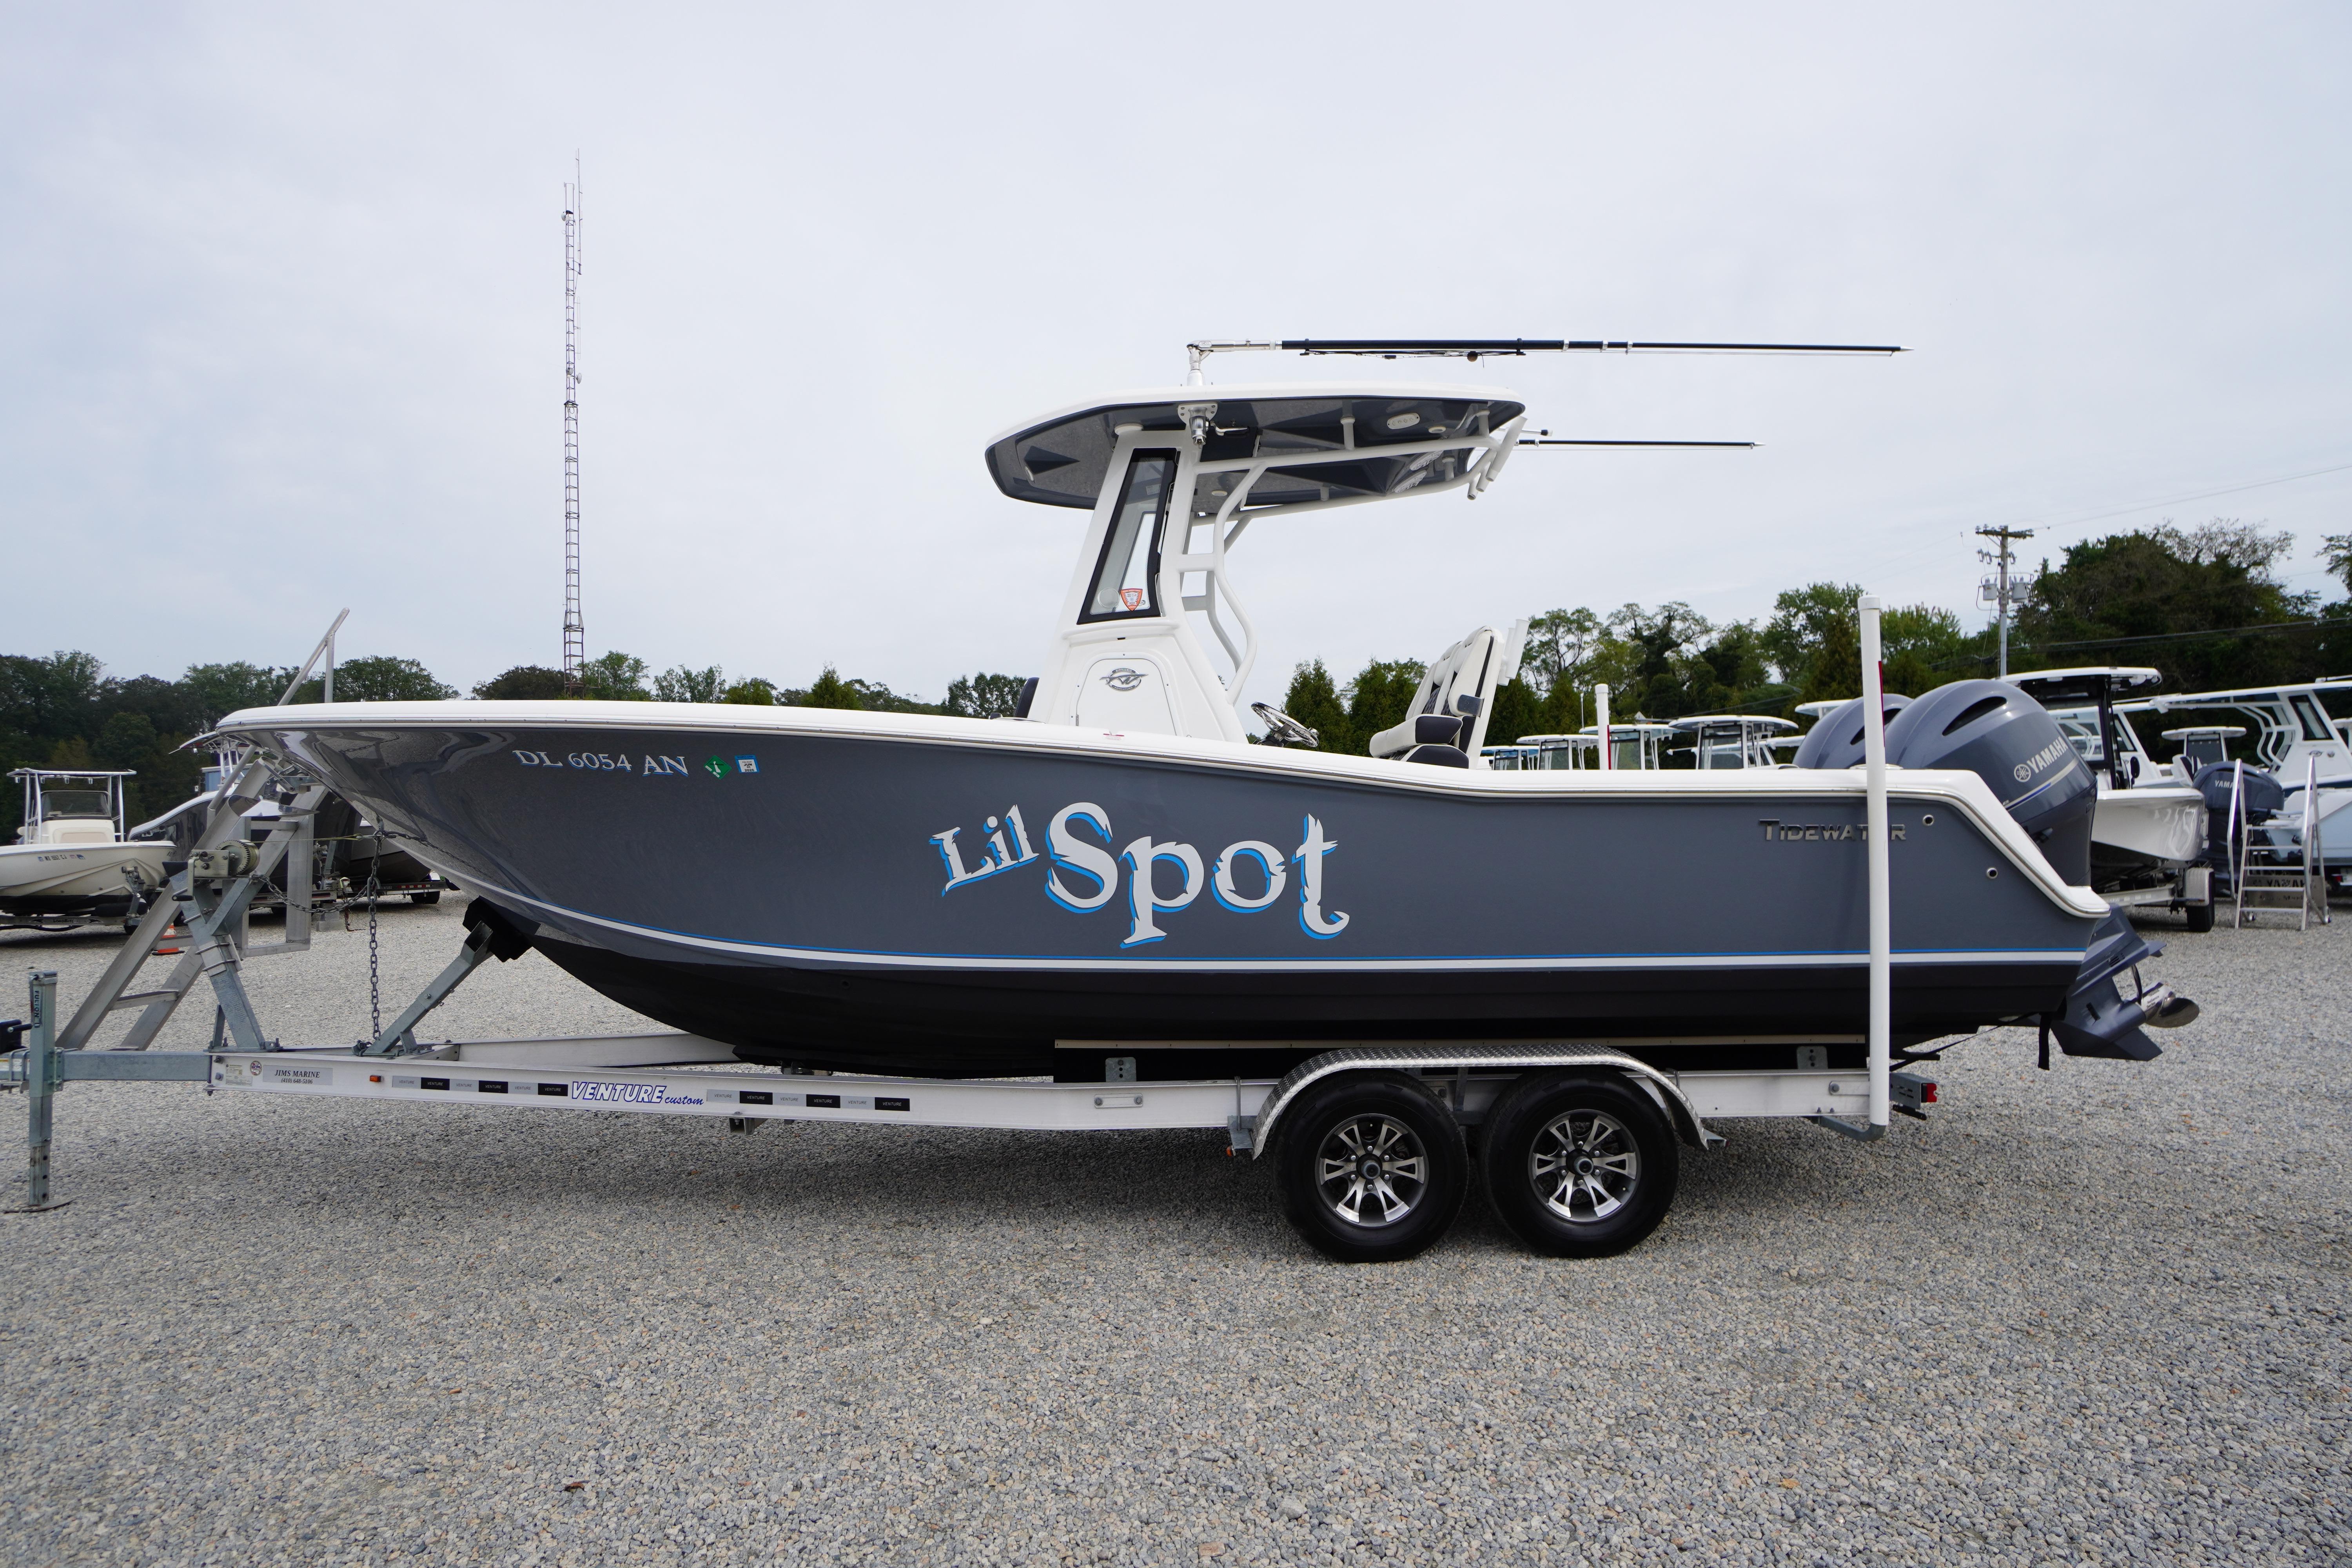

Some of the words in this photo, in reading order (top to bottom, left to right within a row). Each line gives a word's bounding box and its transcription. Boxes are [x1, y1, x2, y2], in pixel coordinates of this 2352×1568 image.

[511, 750, 564, 768] DL
[568, 752, 633, 772] 6054
[642, 755, 689, 777] AN
[2027, 736, 2068, 774] YAMAHA
[1759, 819, 1906, 840] TIDEWATR
[929, 804, 1040, 897] Lil
[1045, 802, 1350, 949] Spot
[572, 1082, 667, 1103] VENTURE
[665, 1096, 704, 1105] custom
